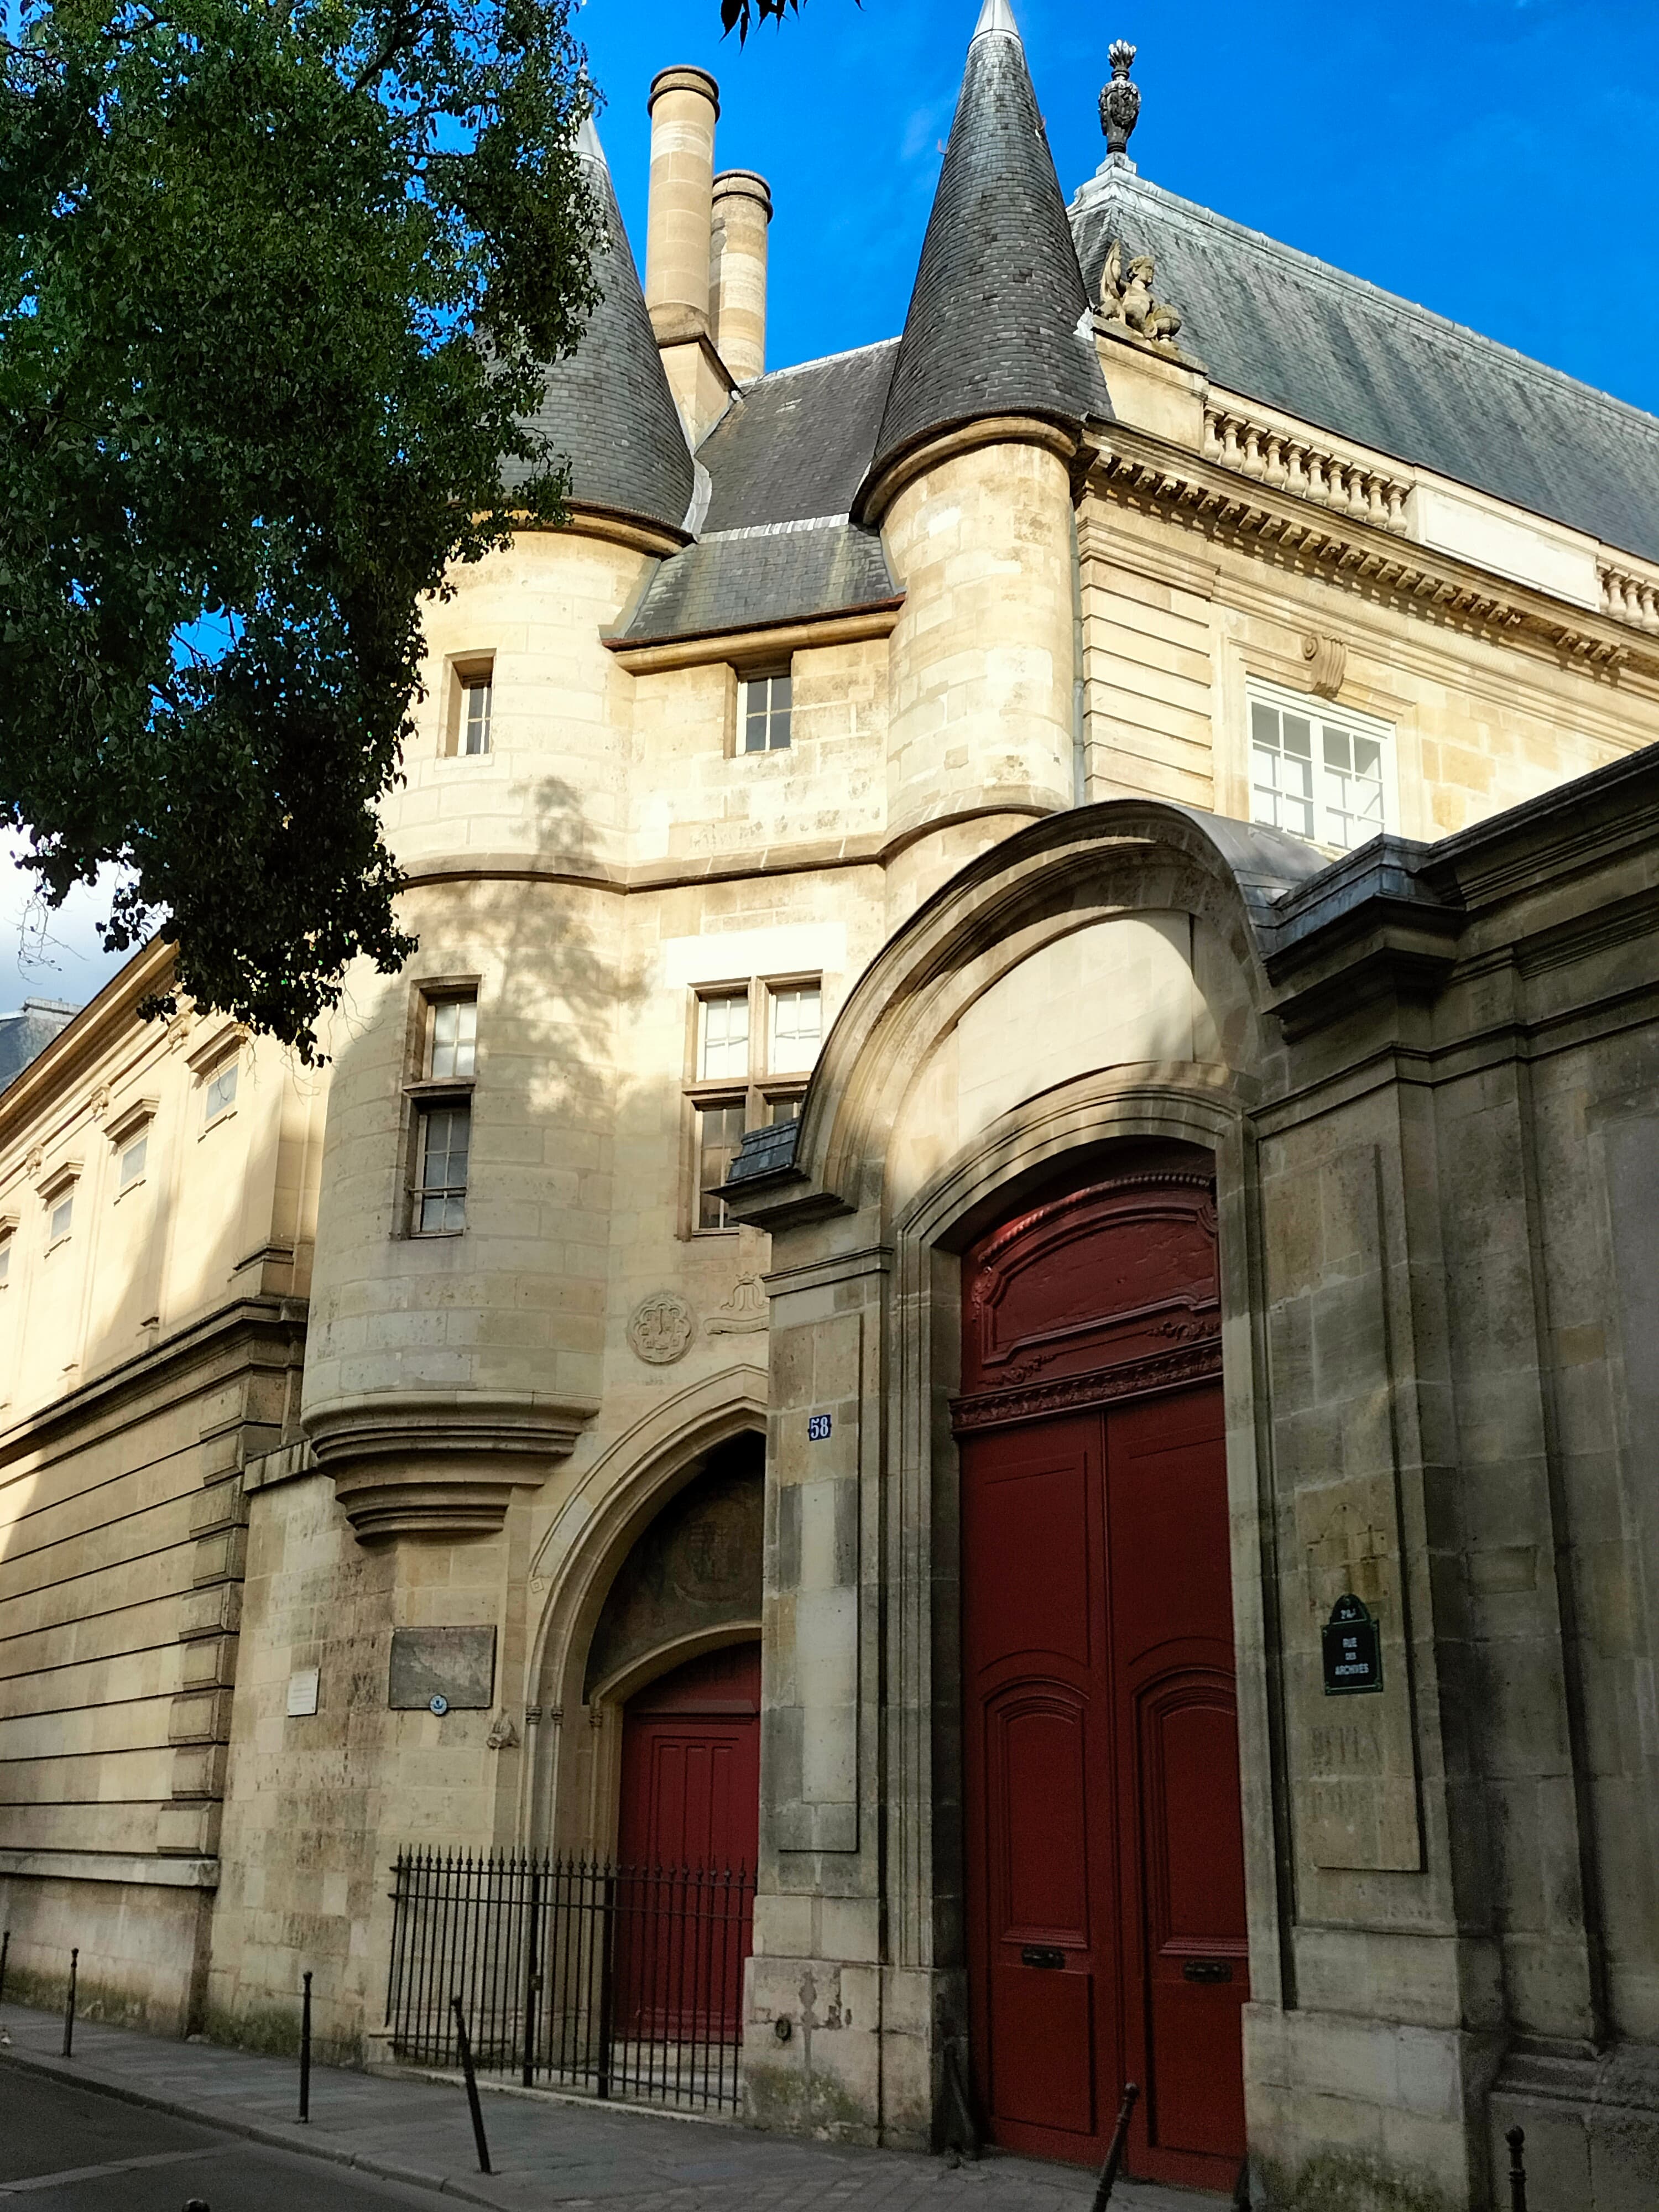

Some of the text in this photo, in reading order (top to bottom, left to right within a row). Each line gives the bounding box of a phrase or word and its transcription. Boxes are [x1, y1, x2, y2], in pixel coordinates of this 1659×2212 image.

[811, 1417, 828, 1439] 58
[1342, 1637, 1358, 1648] RUE
[1334, 1663, 1369, 1676] ARCHIVES
